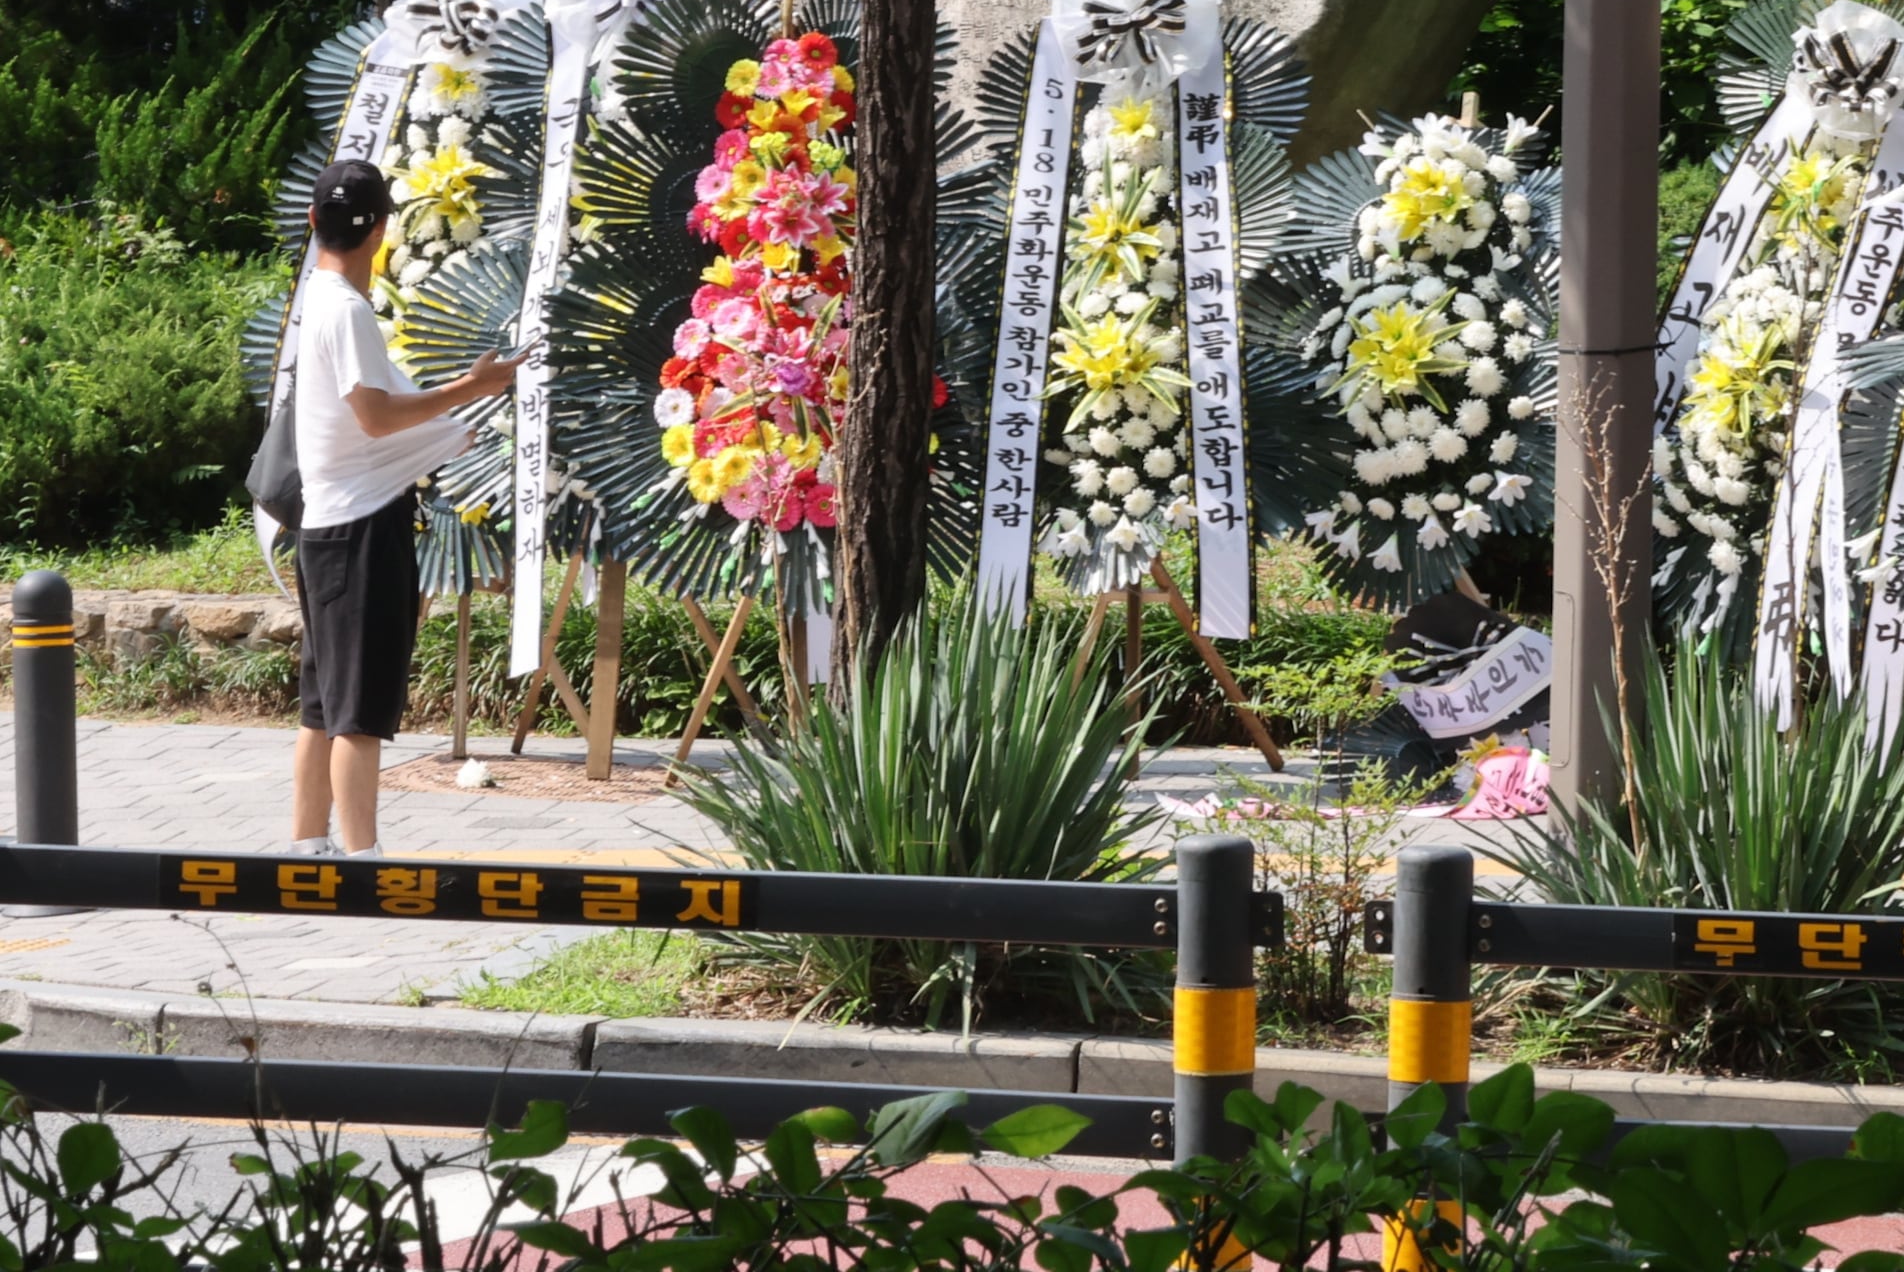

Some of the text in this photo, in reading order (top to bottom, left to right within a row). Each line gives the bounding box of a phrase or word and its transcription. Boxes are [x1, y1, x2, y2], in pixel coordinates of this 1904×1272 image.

[1008, 184, 1055, 317] 민주화운동
[1182, 93, 1244, 530] 謹弔 배재고 폐교를 애도합니다
[1002, 325, 1046, 402] 참가인
[518, 388, 548, 566] 박멸하자
[179, 860, 741, 926] 무단횡단금지
